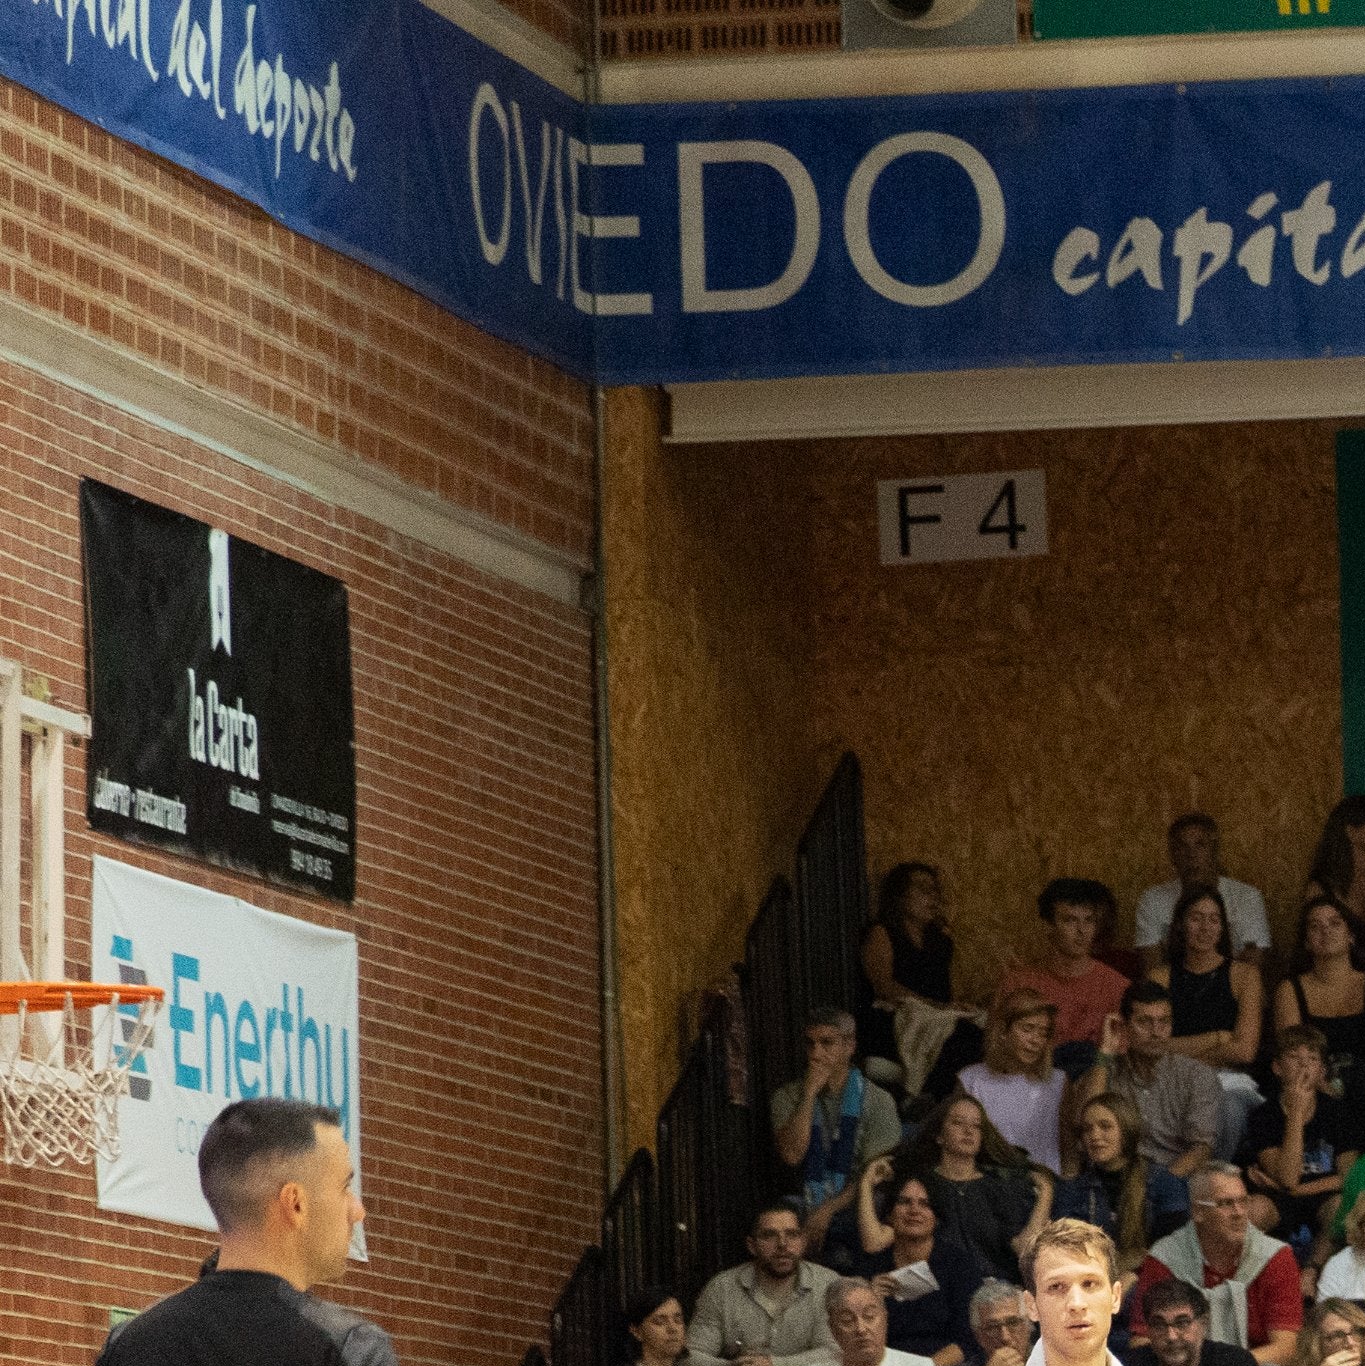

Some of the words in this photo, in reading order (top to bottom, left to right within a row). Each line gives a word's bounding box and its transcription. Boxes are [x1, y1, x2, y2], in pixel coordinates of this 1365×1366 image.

[234, 4, 357, 183] deporte
[468, 81, 1007, 317] OVIEDO
[896, 484, 945, 557] F
[977, 480, 1028, 551] 4
